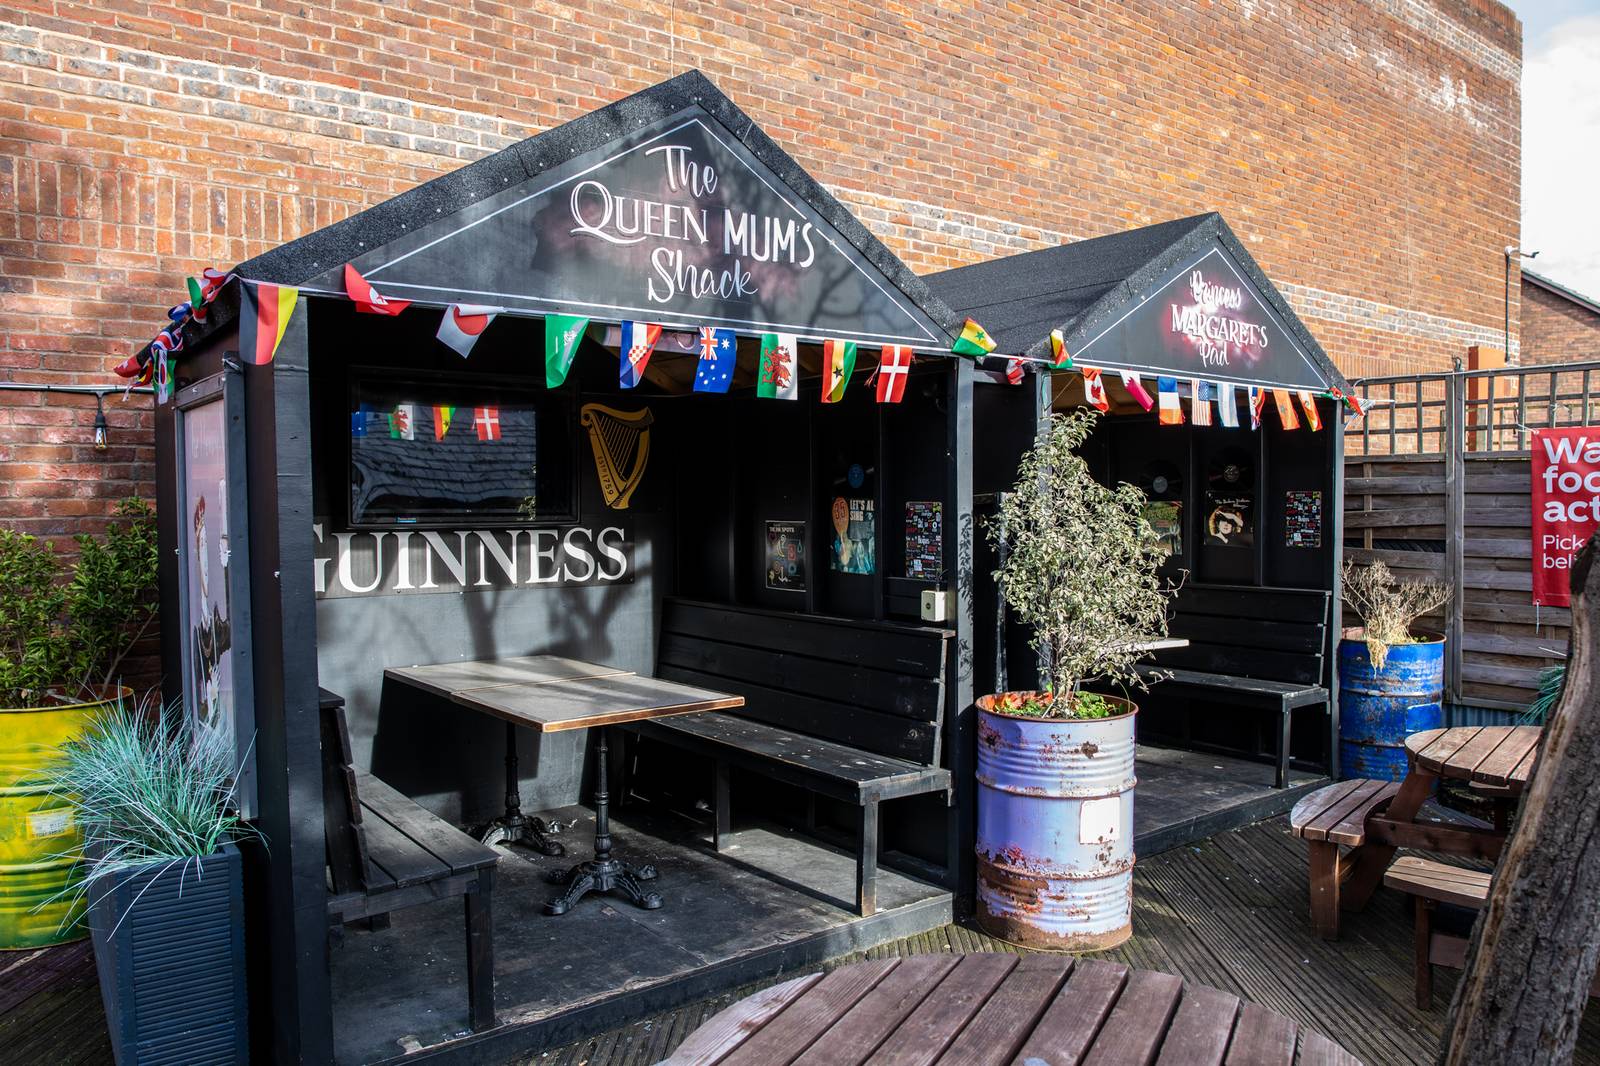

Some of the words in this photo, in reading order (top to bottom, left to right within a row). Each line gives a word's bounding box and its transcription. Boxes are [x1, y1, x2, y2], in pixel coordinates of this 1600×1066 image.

[645, 145, 718, 197] The
[570, 180, 709, 244] QUEEN
[724, 209, 815, 268] MUM'S
[648, 247, 758, 303] Shack
[1171, 304, 1268, 347] MARGARET'S
[1200, 339, 1230, 368] Pad
[849, 499, 865, 511] LET'S
[1543, 534, 1585, 550] Pick
